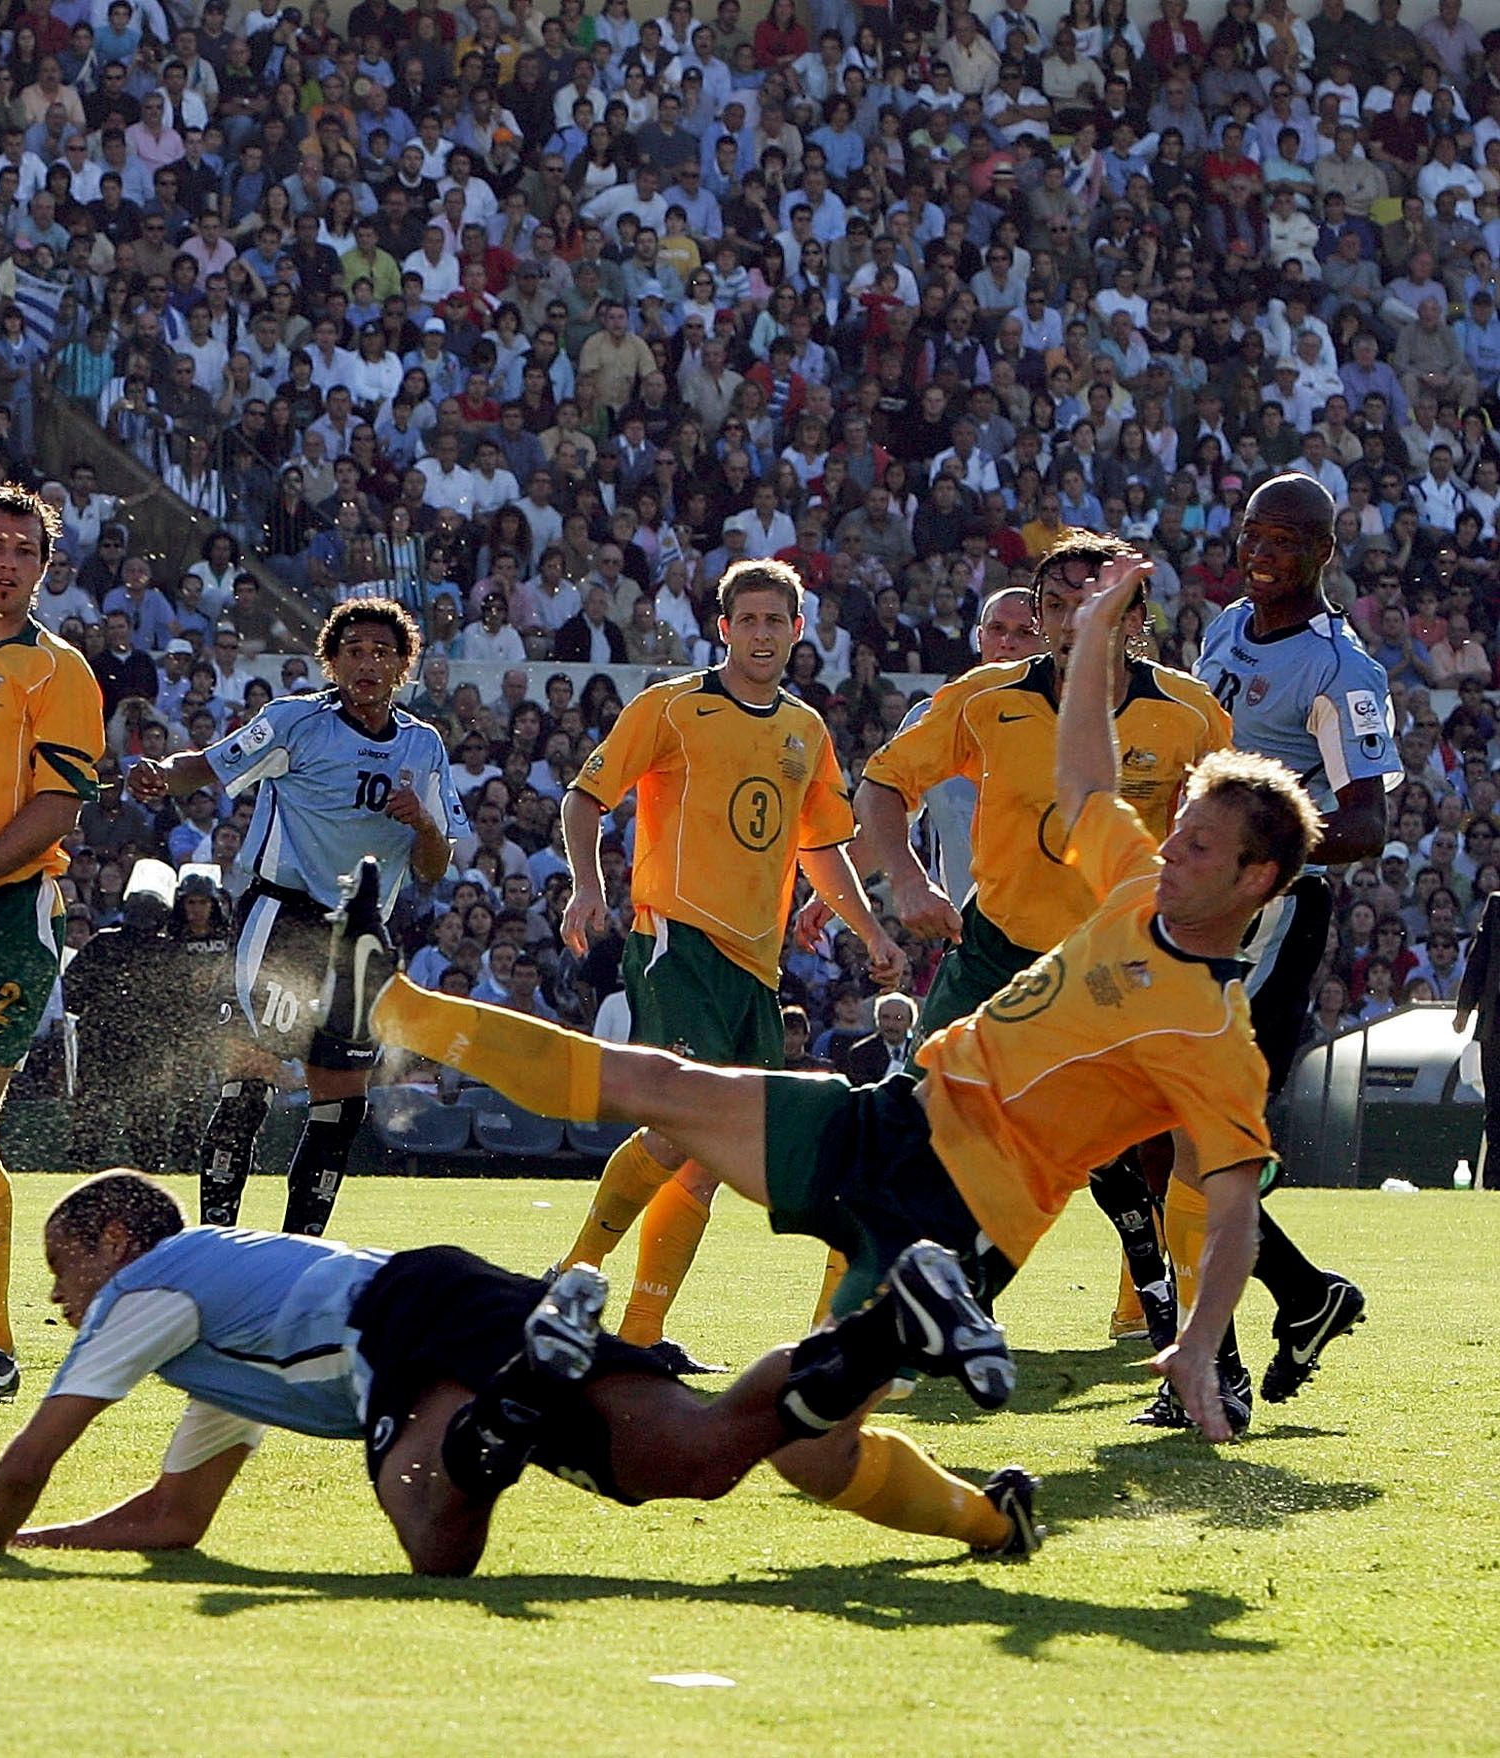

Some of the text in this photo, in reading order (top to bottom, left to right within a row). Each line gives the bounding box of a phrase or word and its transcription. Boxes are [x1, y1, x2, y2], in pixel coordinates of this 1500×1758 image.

[352, 769, 392, 812] 10
[749, 790, 768, 839] 3
[261, 980, 298, 1034] 10
